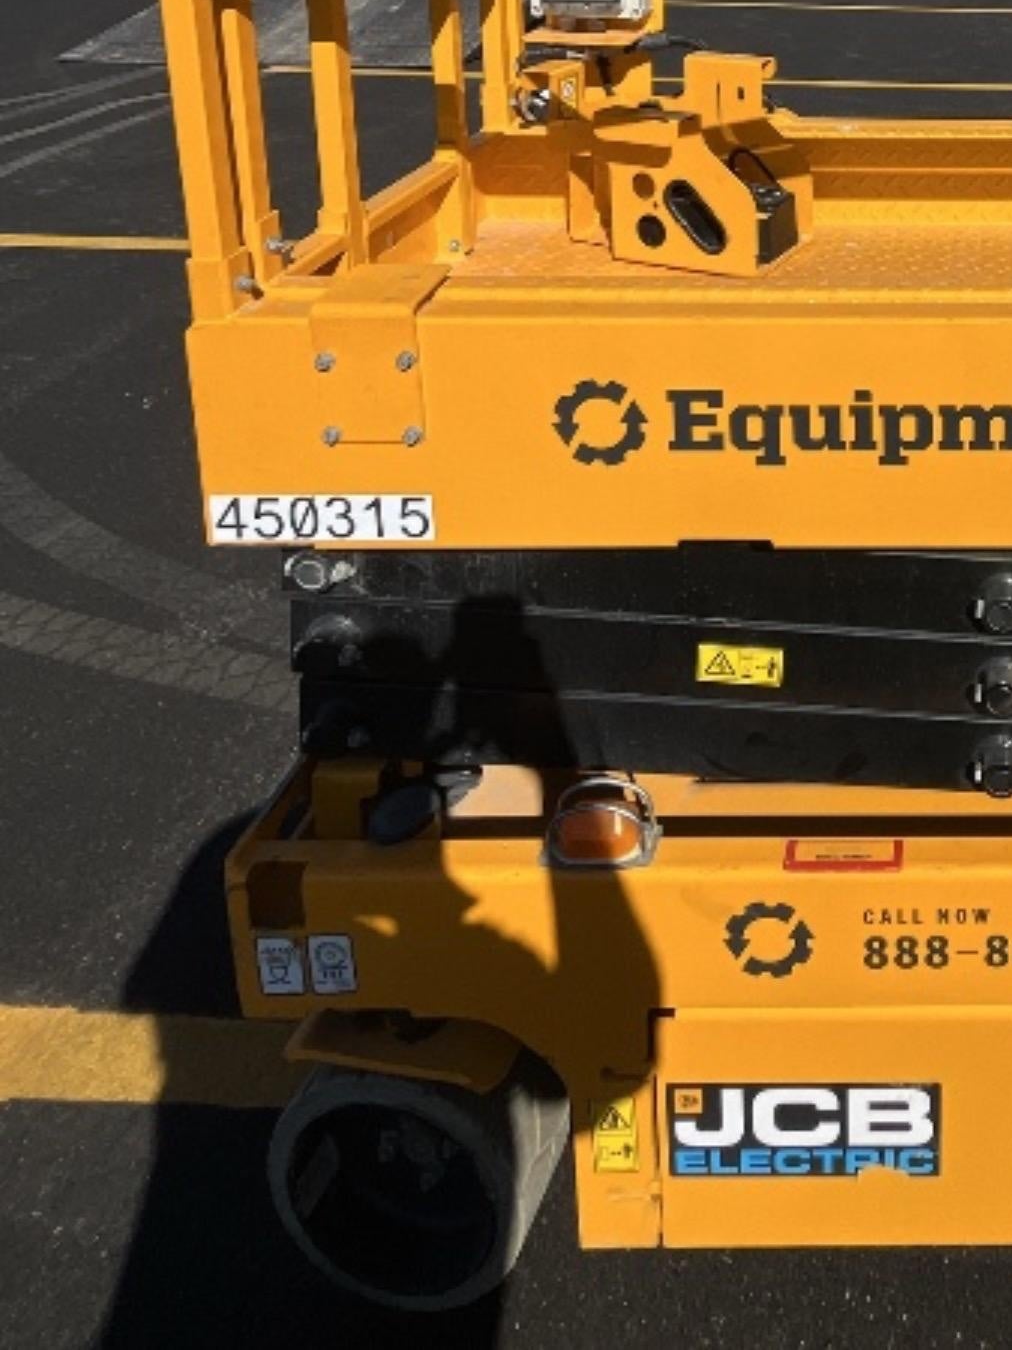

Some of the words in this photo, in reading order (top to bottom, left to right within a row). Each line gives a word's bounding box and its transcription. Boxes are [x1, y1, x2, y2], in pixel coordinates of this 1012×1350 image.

[216, 497, 429, 538] 450315
[863, 908, 924, 925] CALL
[937, 908, 991, 925] NOW
[674, 1088, 934, 1147] JCB
[675, 1148, 934, 1173] ELECTRIC
